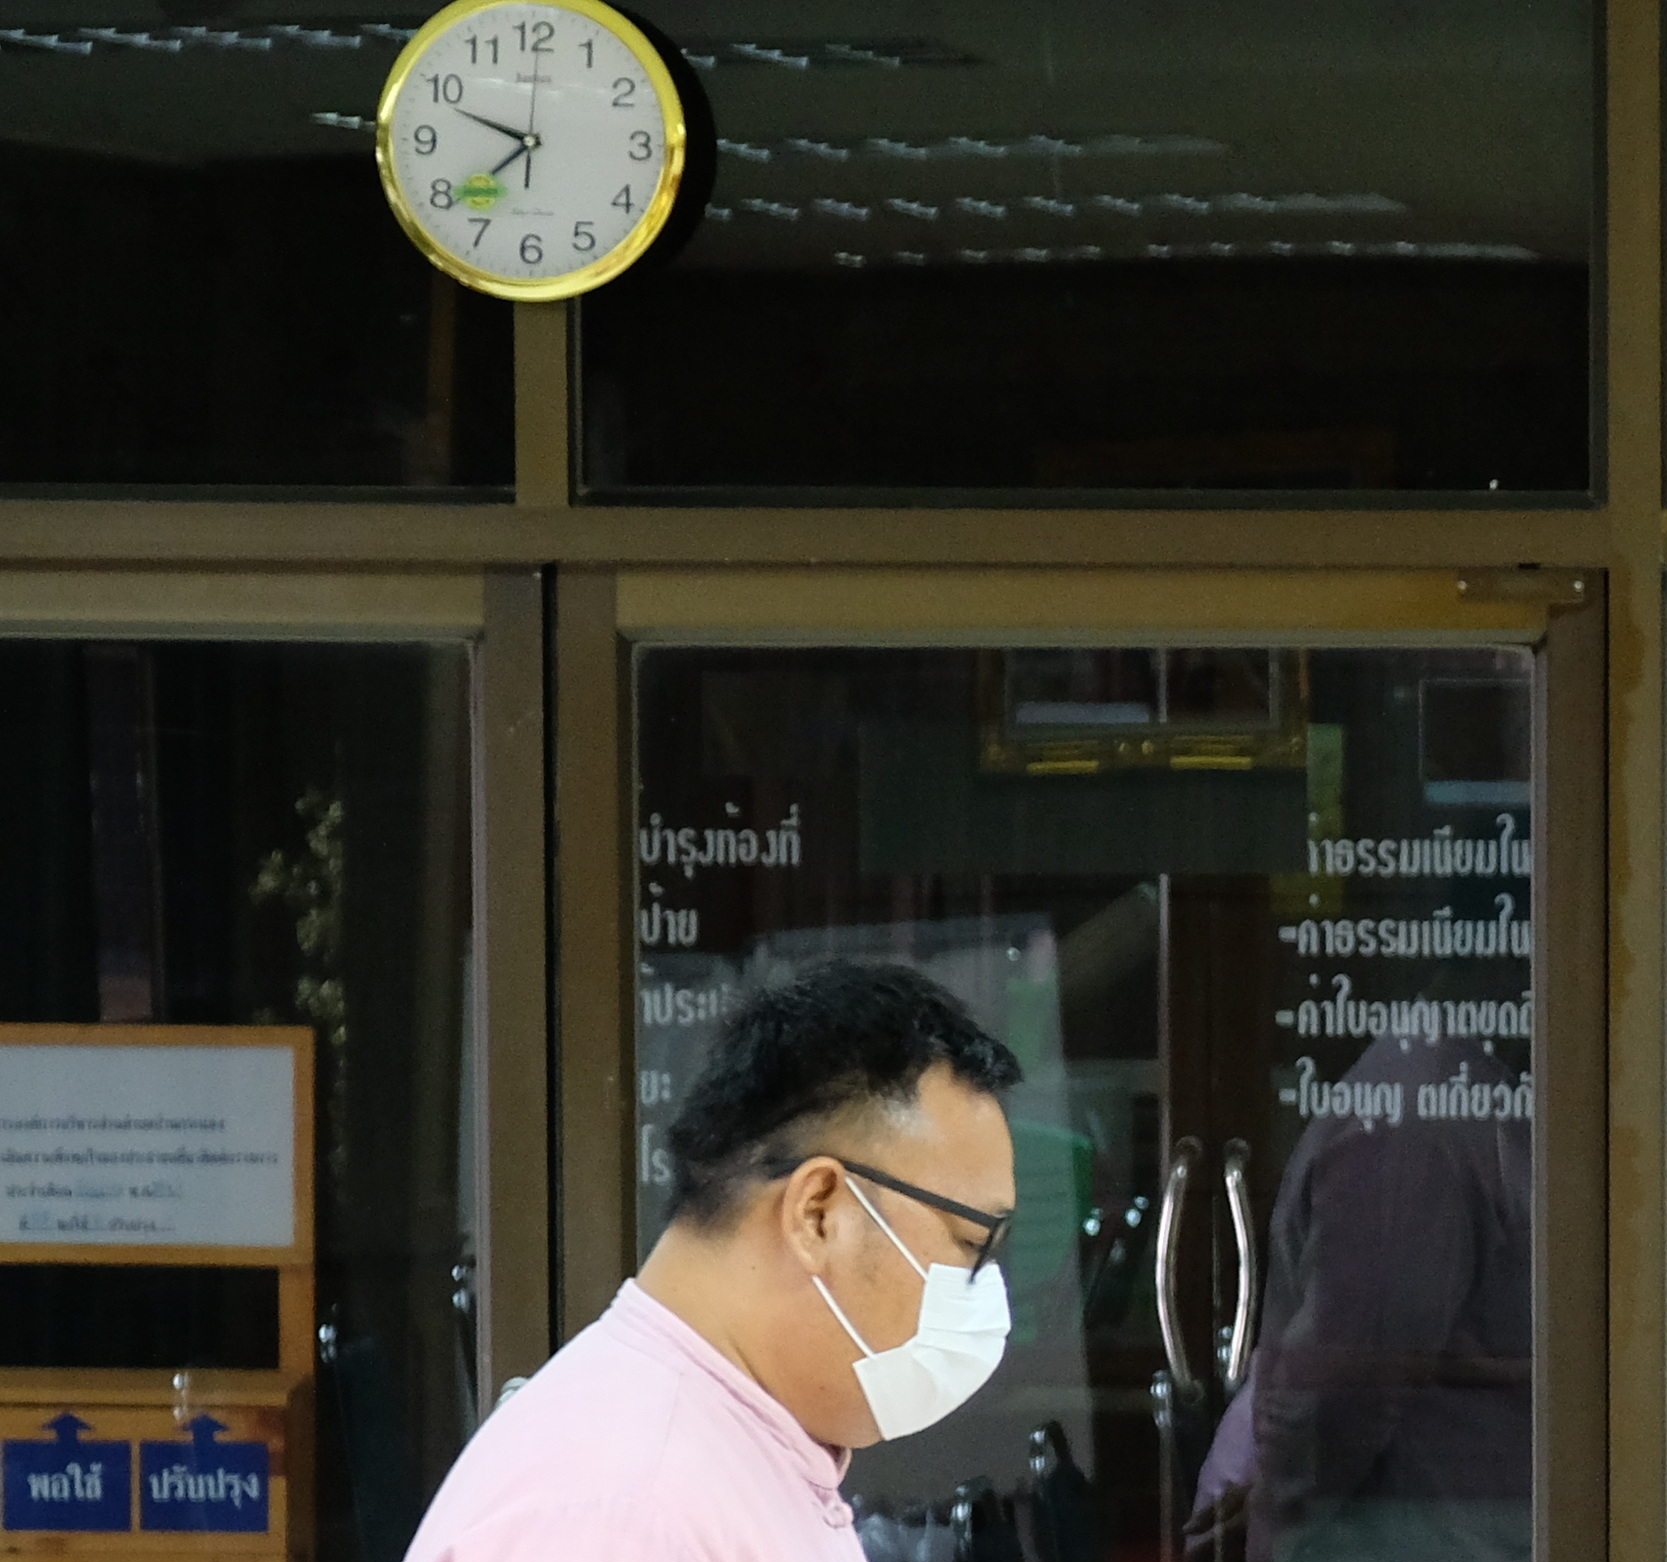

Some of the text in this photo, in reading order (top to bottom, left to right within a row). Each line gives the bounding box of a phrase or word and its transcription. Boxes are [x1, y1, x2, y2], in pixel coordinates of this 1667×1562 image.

[465, 34, 499, 65] 11
[513, 21, 555, 53] 12
[579, 38, 593, 69] 1
[424, 73, 463, 104] 10
[612, 77, 636, 108] 2
[414, 125, 438, 155] 9
[628, 130, 653, 161] 3
[429, 178, 454, 209] 8
[611, 184, 634, 214] 4
[467, 217, 491, 248] 7
[572, 221, 596, 251] 5
[519, 233, 543, 264] 6
[27, 1462, 103, 1502] พอใช้
[149, 1464, 260, 1510] ปรับปรุง
